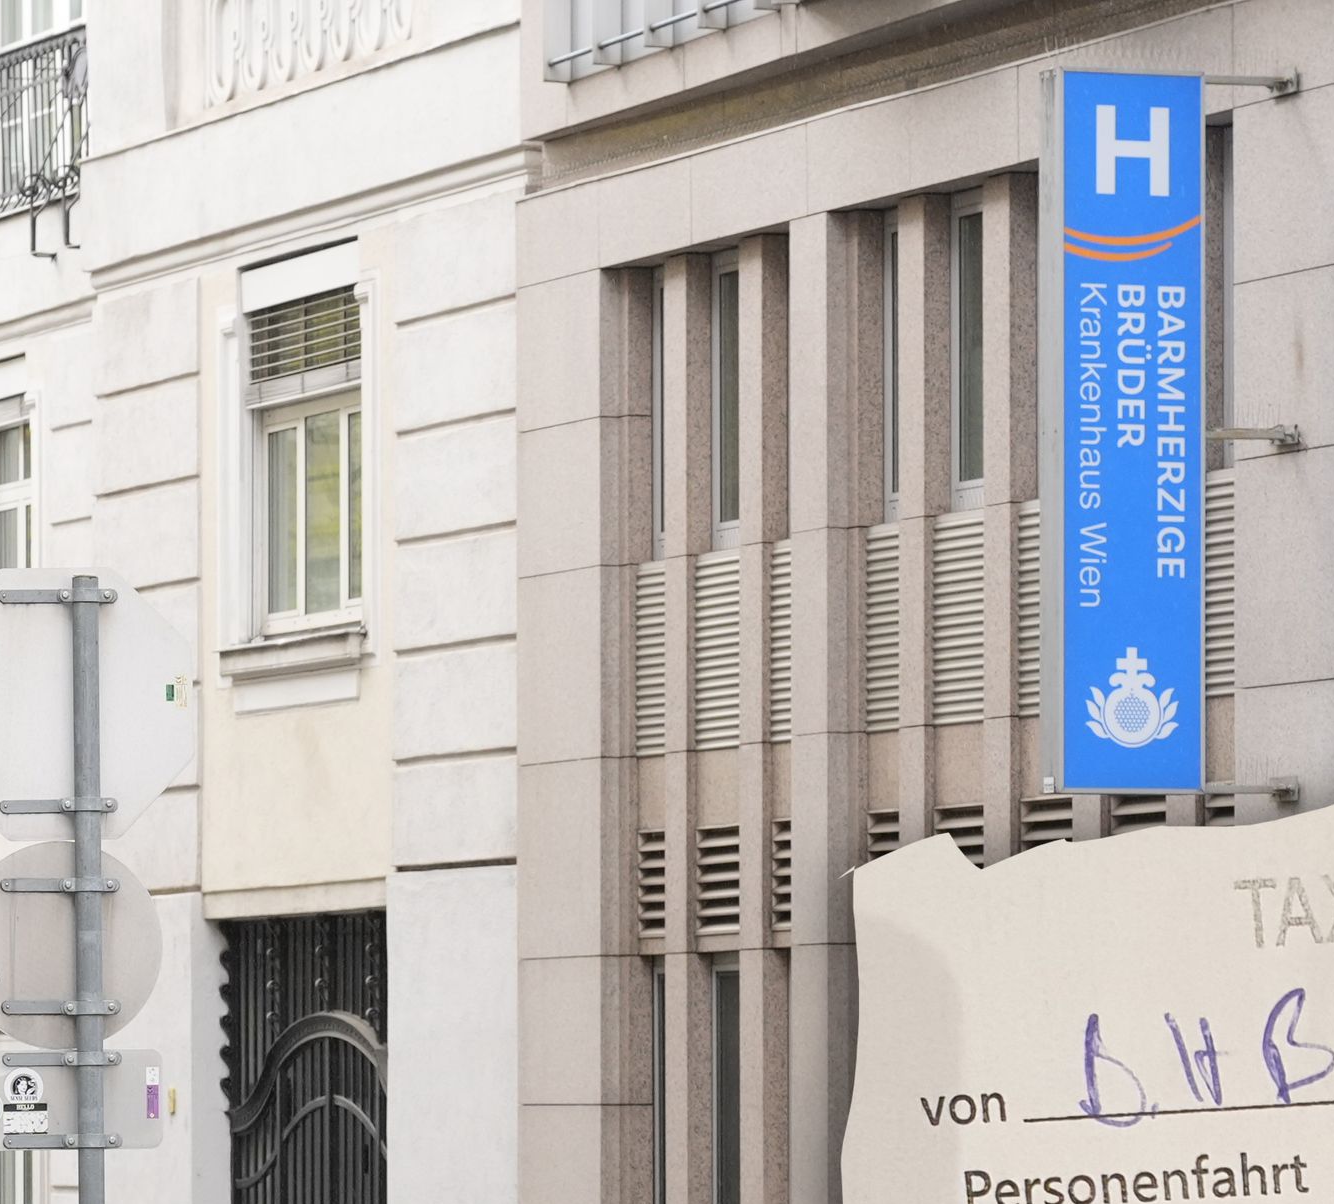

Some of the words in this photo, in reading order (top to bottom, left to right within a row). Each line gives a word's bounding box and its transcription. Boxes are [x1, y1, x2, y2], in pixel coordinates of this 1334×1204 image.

[1096, 104, 1170, 197] H
[1080, 283, 1108, 509] Krankenhaus
[1117, 284, 1152, 448] BRÜDER
[1157, 285, 1186, 579] BARMHERZIGE
[1080, 522, 1108, 608] Wien
[919, 1091, 1007, 1127] von
